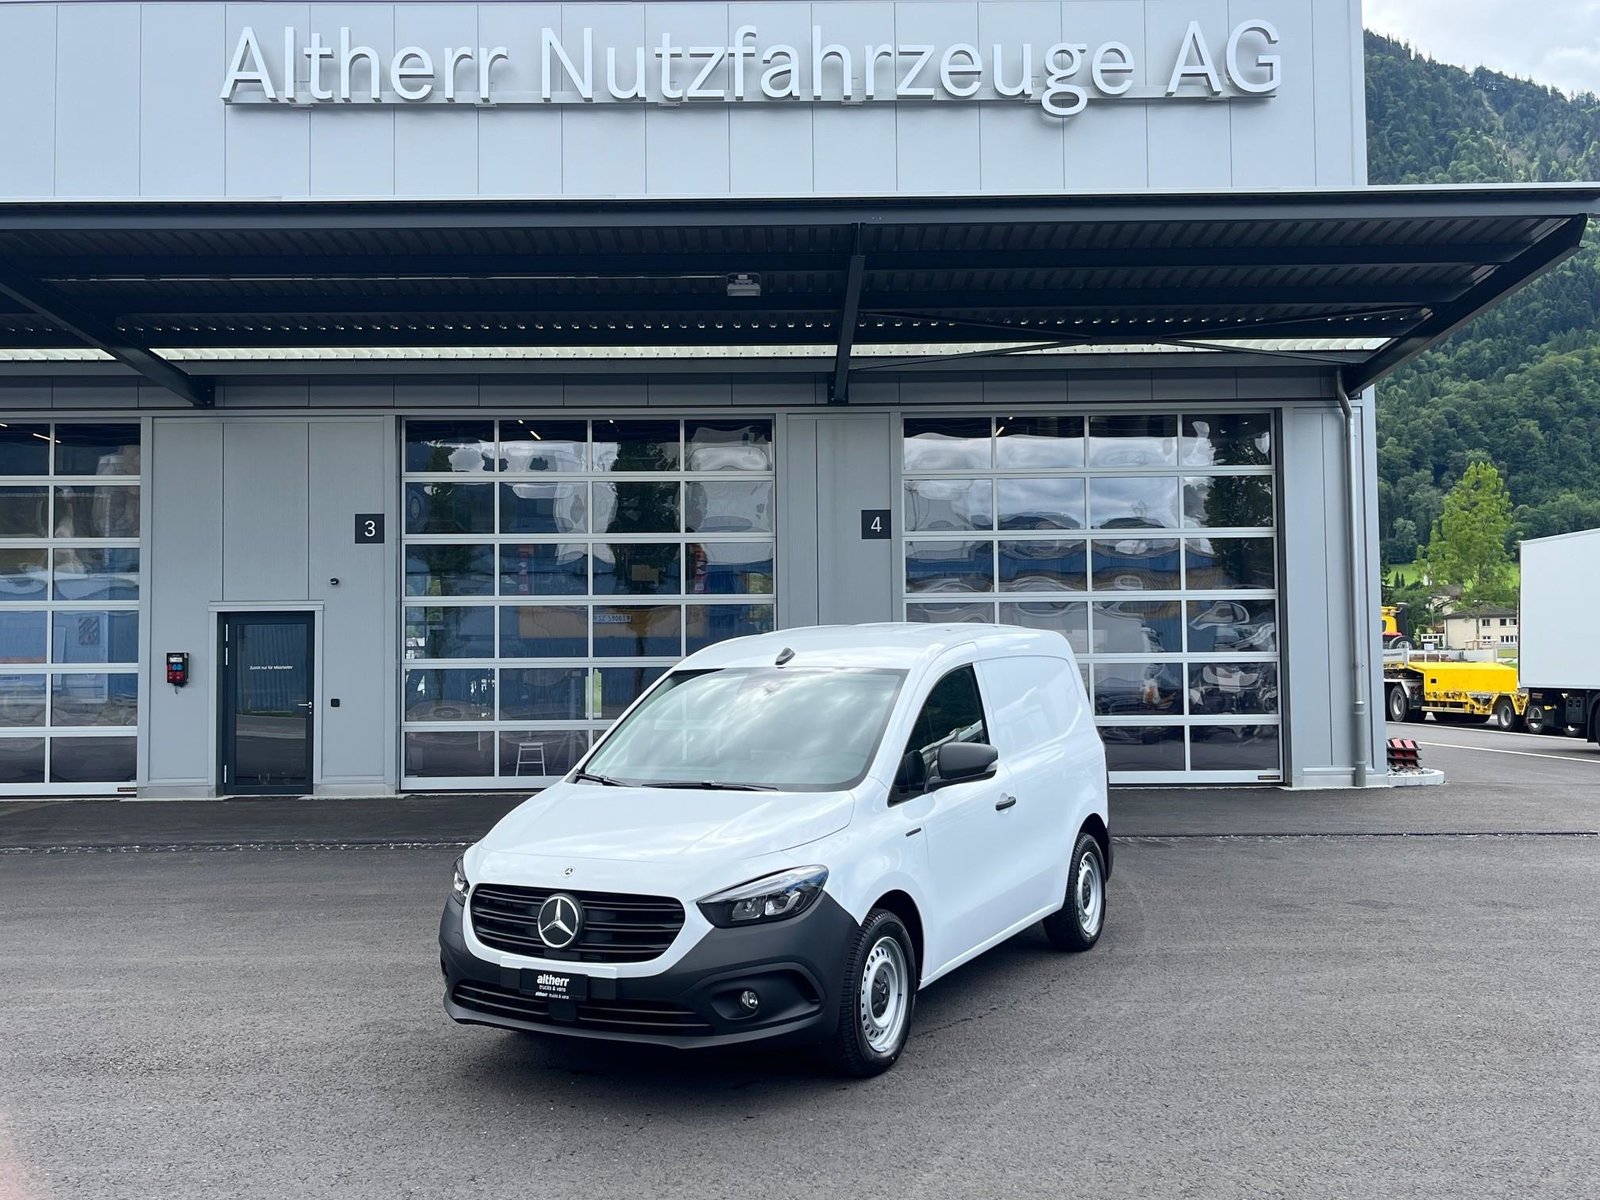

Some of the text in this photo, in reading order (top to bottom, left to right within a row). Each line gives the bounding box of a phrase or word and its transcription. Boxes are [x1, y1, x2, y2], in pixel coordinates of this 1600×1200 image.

[220, 18, 1282, 116] Altherr Nutzfahrzeuge AG
[364, 520, 376, 537] 3
[871, 516, 882, 533] 4
[536, 973, 570, 987] altherr
